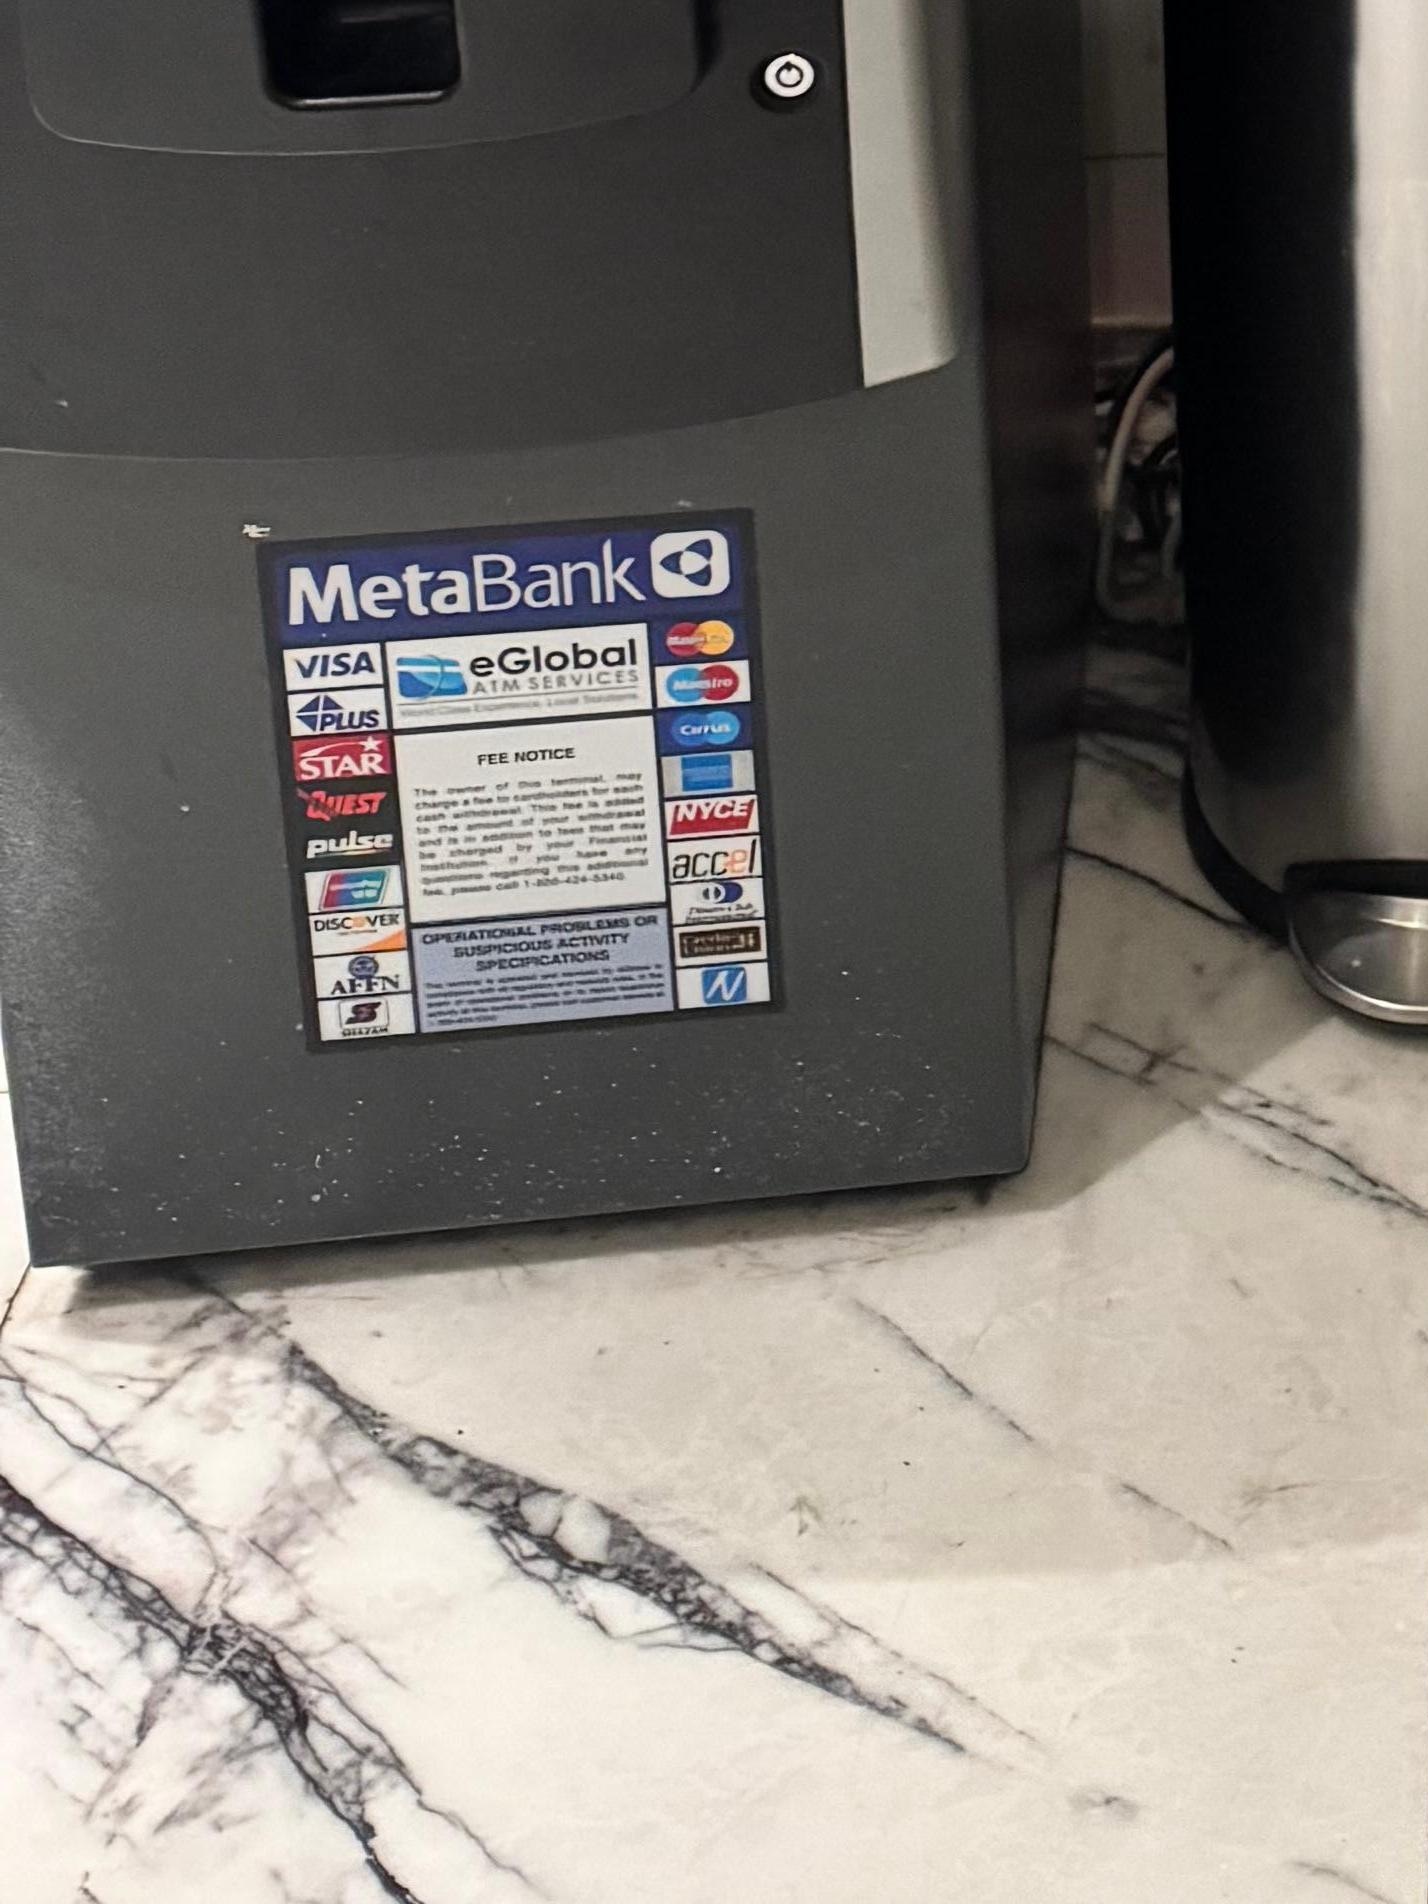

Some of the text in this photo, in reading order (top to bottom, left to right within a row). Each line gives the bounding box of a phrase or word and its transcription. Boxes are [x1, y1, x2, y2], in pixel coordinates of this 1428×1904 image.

[289, 538, 646, 625] MetaBank
[295, 651, 375, 678] VISA
[470, 639, 637, 677] eGlobal
[473, 670, 639, 695] ATM SERVICES
[673, 677, 733, 690] Maestro
[320, 709, 379, 731] PLUS
[680, 723, 731, 736] Cirrus
[300, 753, 387, 781] STAR
[478, 748, 576, 766] FEE NOTICE
[496, 782, 509, 791] of
[677, 799, 750, 823] NYCE
[307, 830, 393, 859] pulse
[672, 839, 757, 880] accel
[496, 882, 519, 890] call
[314, 913, 400, 932] DISCOVER
[422, 915, 659, 946] OPERATIONAL PROBLEMS OR
[453, 932, 631, 958] SUSPICIOUS ACTIVITY
[475, 950, 610, 972] SPECIFICATIONS
[331, 974, 400, 994] AFFN
